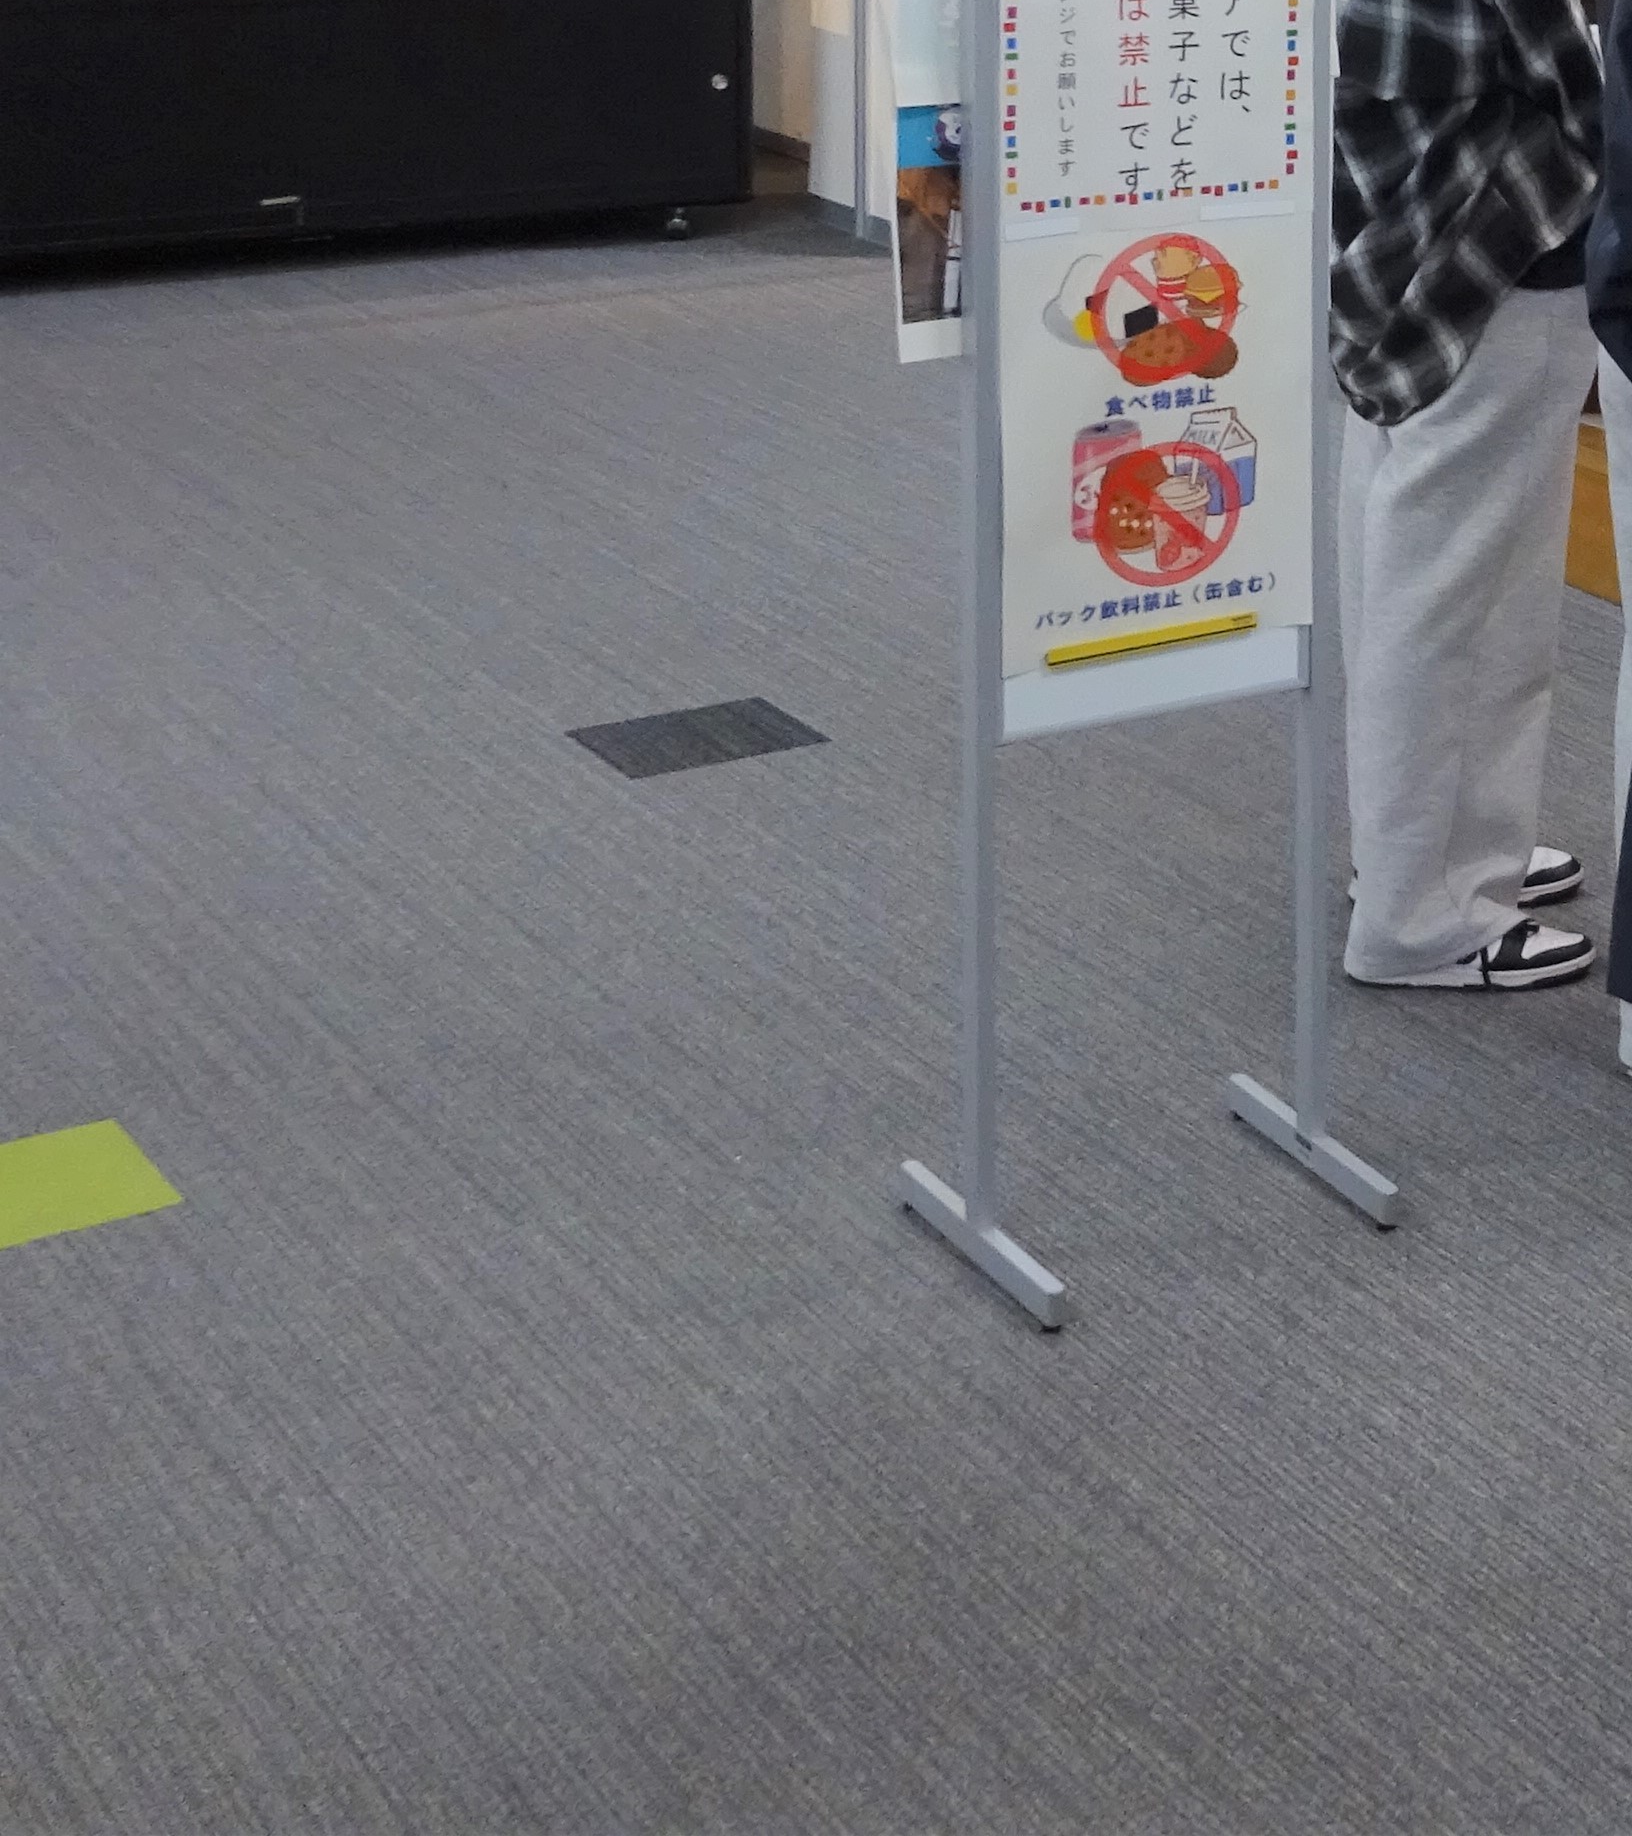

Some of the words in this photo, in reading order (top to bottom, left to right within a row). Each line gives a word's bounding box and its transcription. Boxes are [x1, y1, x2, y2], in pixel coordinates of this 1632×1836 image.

[1104, 383, 1216, 418] 食べ物禁止
[1034, 571, 1277, 631] パック飲料禁止（缶含む）
